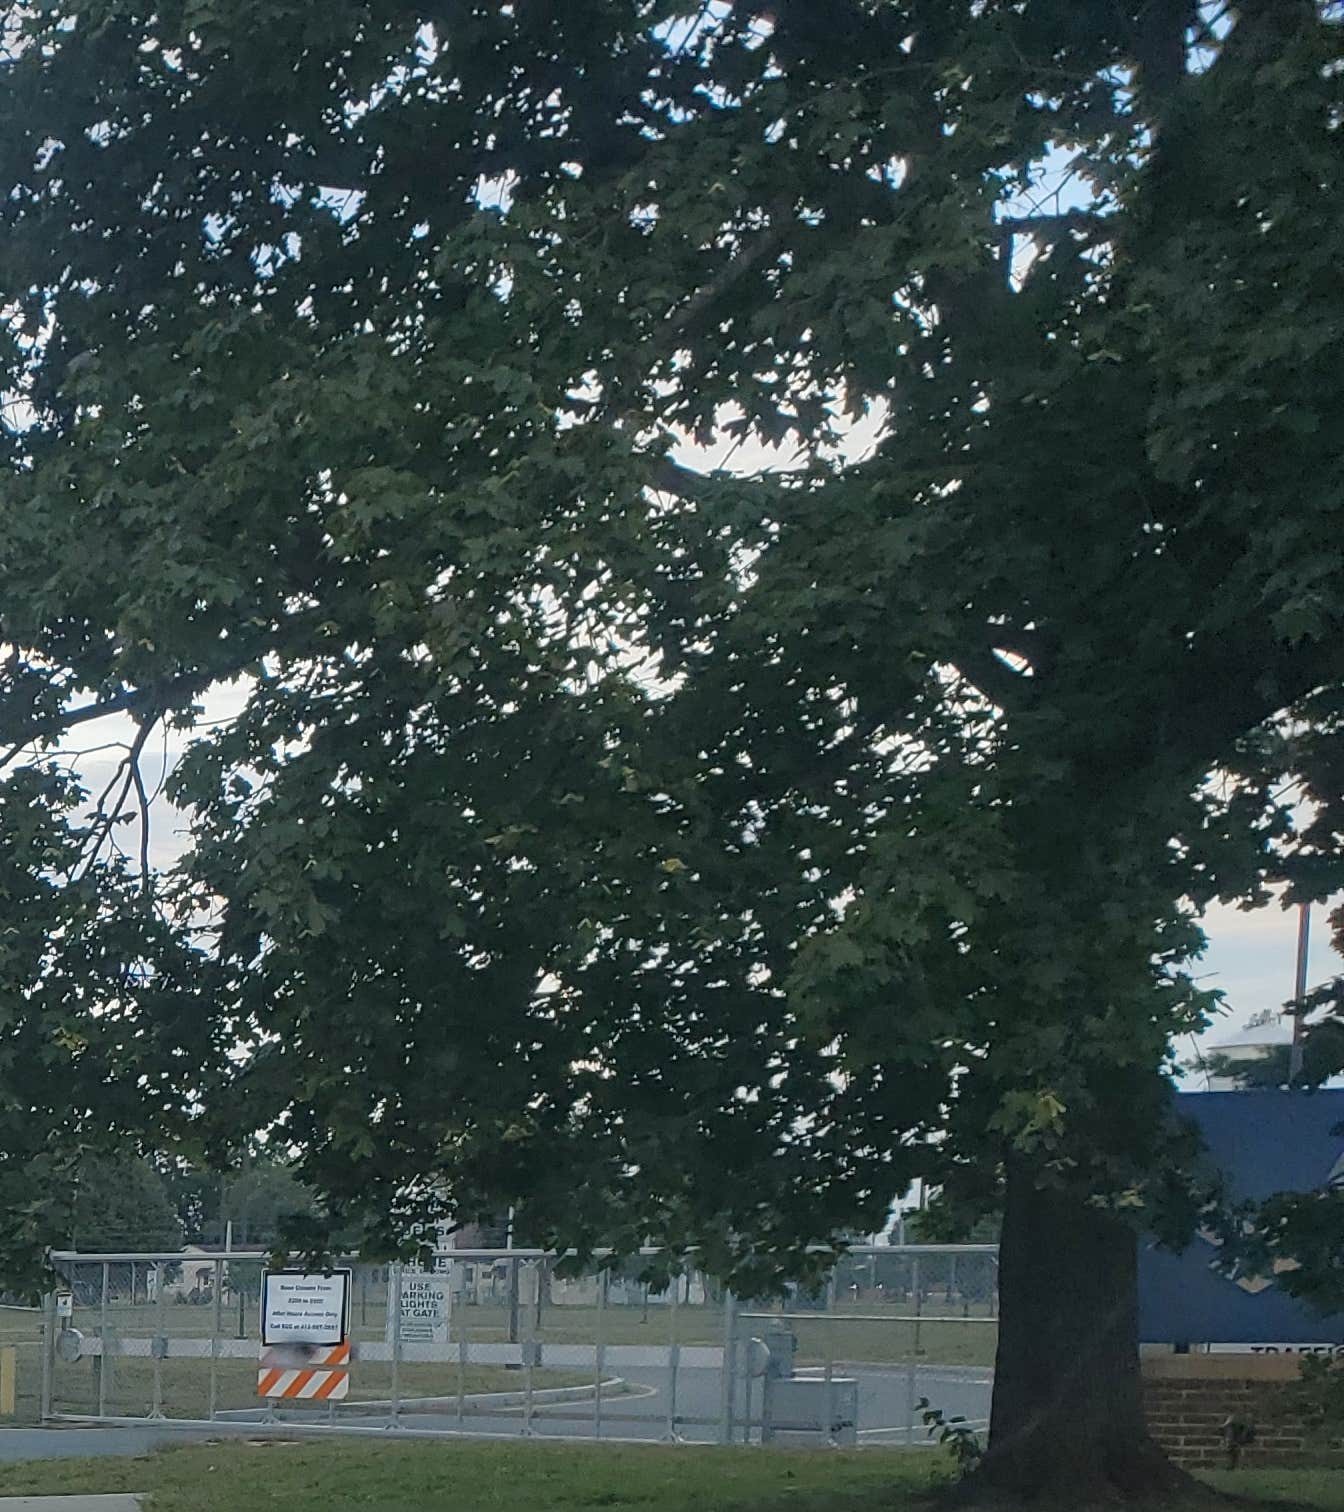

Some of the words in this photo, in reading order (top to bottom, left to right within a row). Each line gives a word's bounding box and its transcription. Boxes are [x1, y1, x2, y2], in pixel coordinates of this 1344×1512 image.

[409, 1282, 430, 1290] USE
[402, 1291, 444, 1301] ARKING
[400, 1300, 438, 1309] LIGHTS
